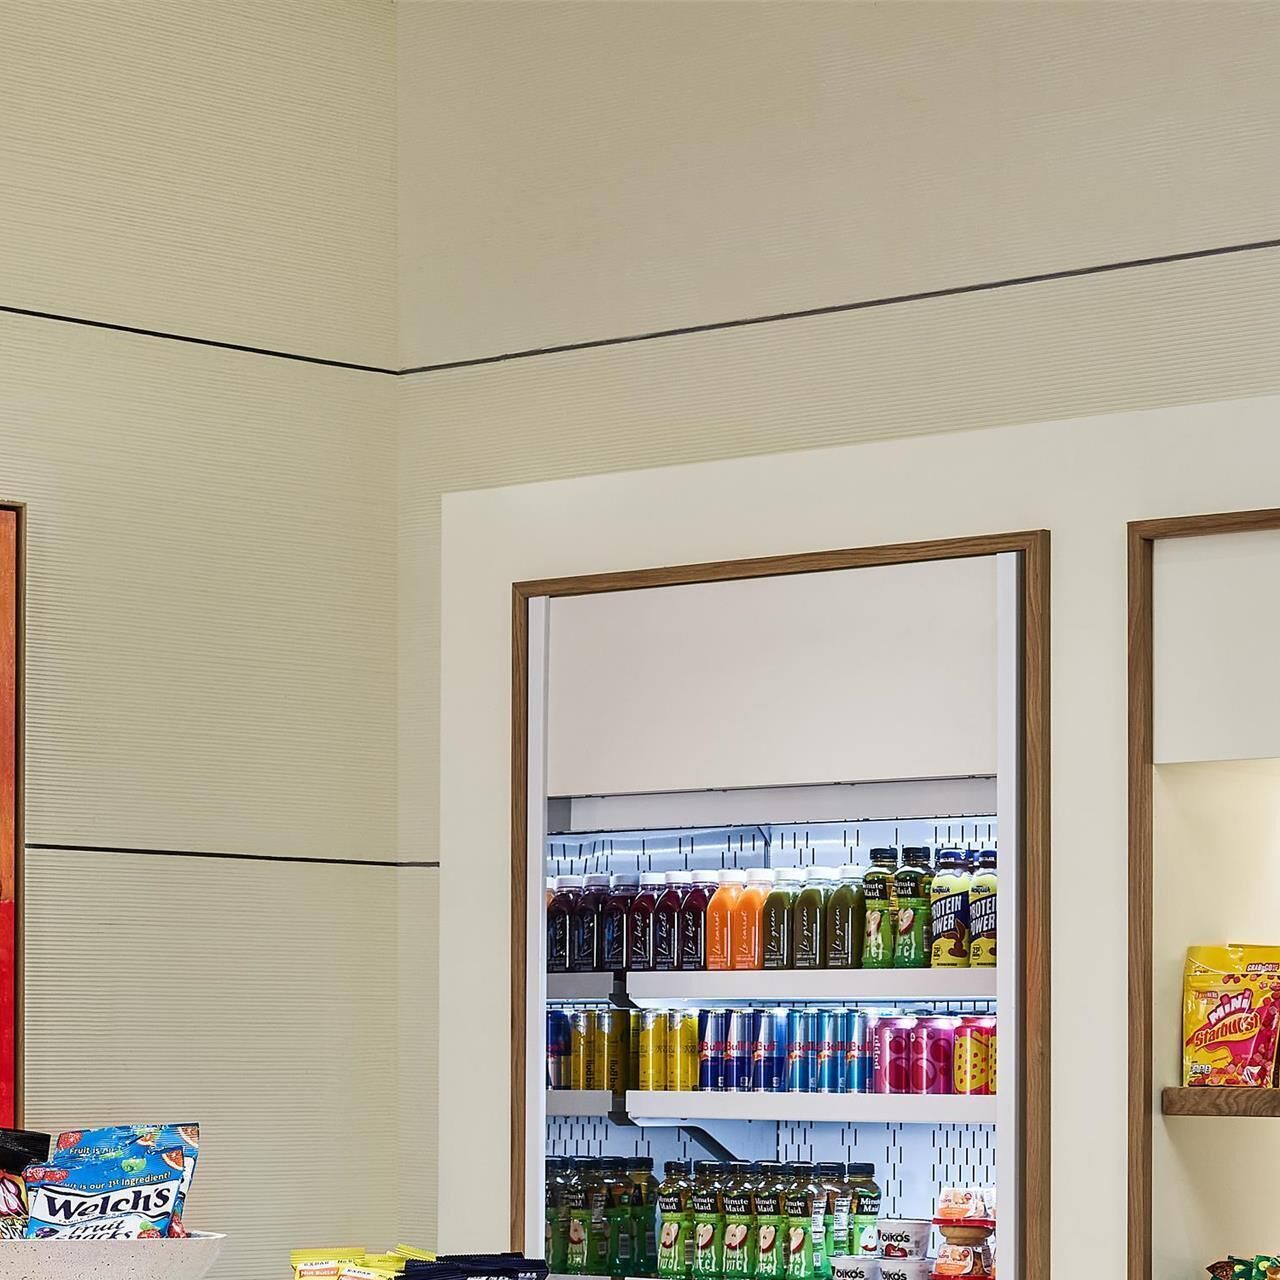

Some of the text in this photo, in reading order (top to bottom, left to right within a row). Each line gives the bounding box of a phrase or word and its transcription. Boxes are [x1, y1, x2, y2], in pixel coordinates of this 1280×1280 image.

[932, 914, 956, 936] OWER
[89, 1182, 105, 1190] our
[121, 1172, 170, 1187] Ingredient!
[43, 1185, 171, 1220] Welch's
